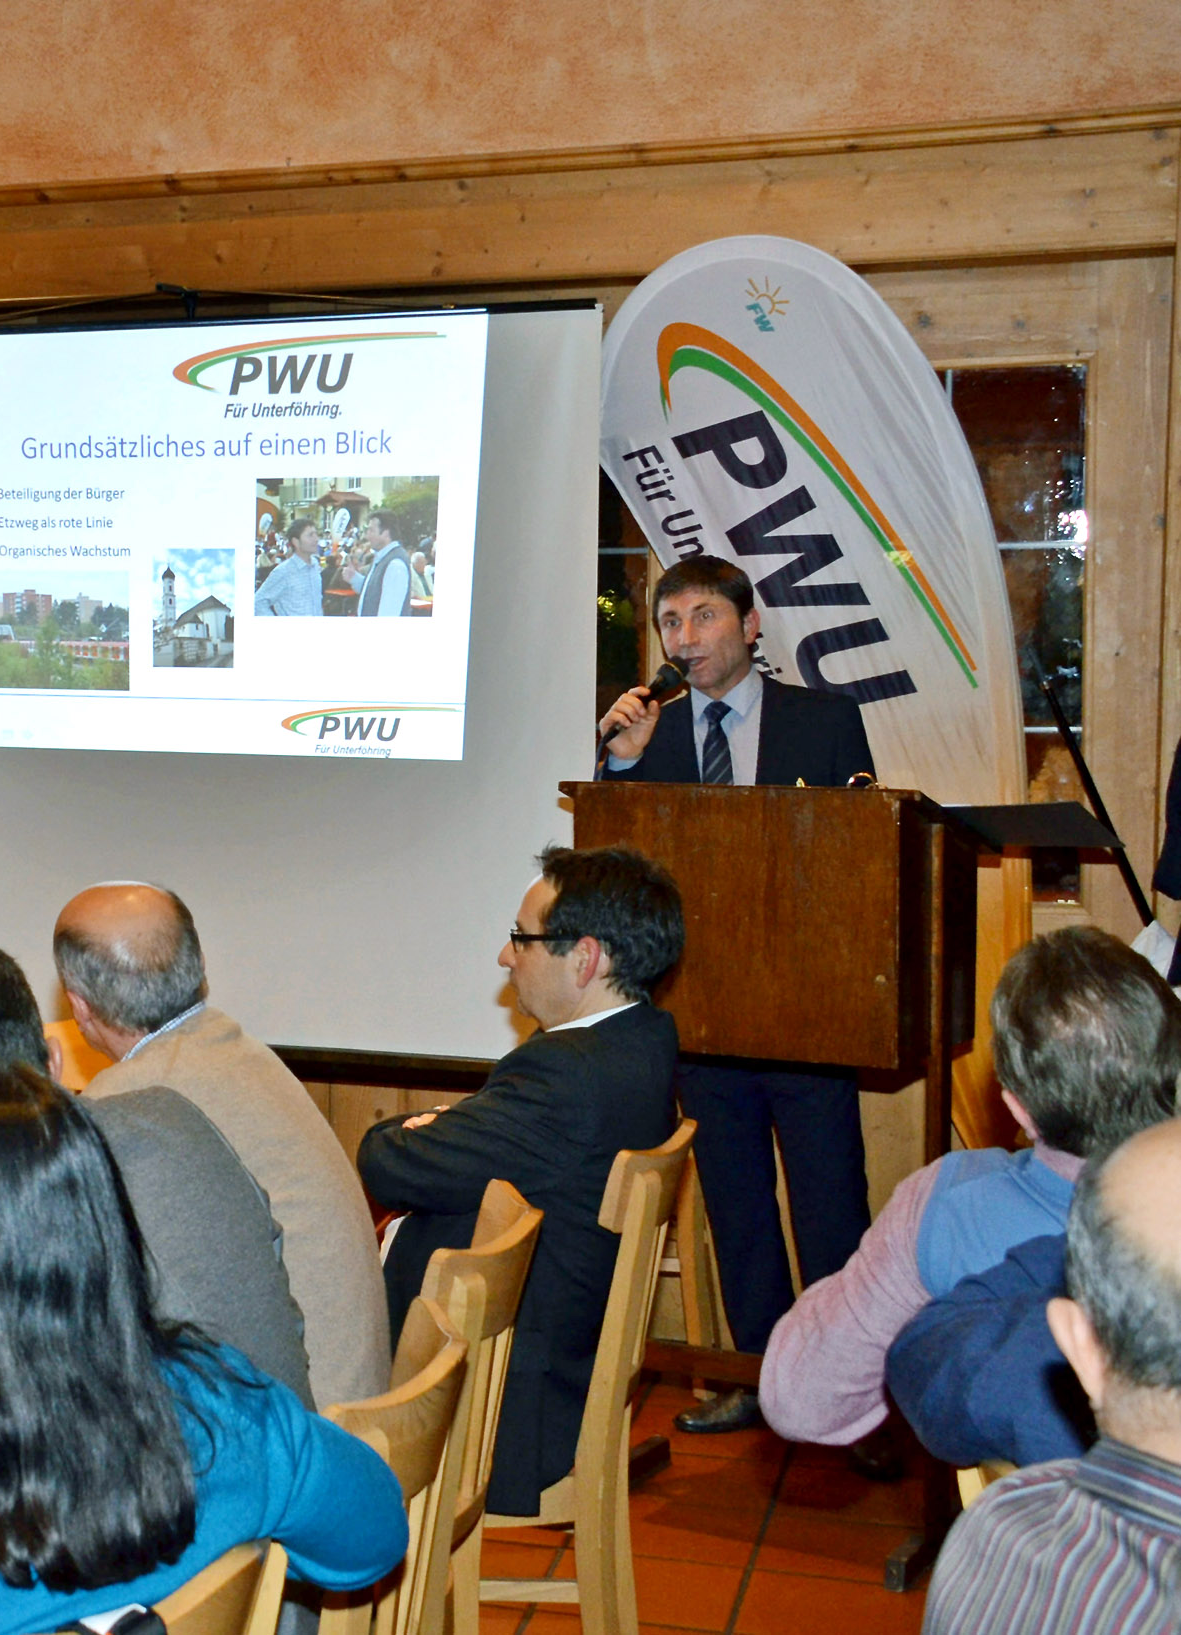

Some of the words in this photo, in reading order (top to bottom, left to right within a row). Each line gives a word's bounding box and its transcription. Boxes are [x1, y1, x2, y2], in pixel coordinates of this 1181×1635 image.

[228, 352, 354, 396] PWU
[223, 403, 249, 419] Für
[251, 400, 343, 420] Unterföhring.
[20, 433, 206, 461] Grundsätzliches
[214, 432, 252, 457] auf
[259, 433, 326, 456] einen
[335, 429, 393, 455] Blick
[622, 444, 676, 506] Für
[63, 487, 83, 500] der
[85, 487, 125, 503] Bürger
[40, 516, 57, 529] als
[59, 518, 83, 529] rote
[85, 516, 114, 529] Linie
[69, 545, 131, 557] Wachstum
[671, 410, 918, 706] PWU
[318, 715, 401, 742] PWU
